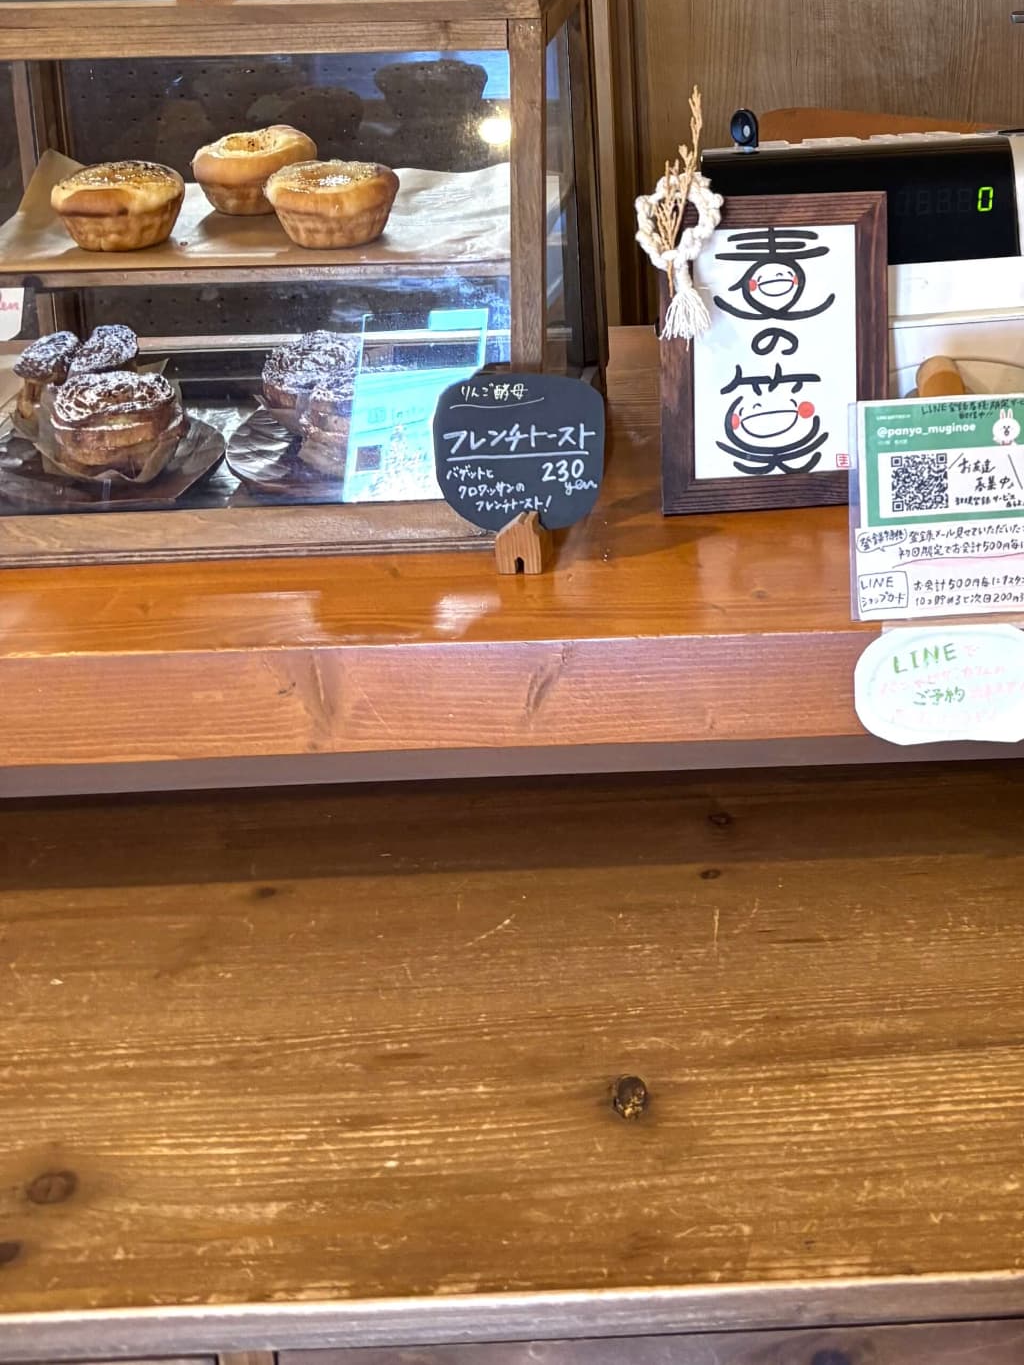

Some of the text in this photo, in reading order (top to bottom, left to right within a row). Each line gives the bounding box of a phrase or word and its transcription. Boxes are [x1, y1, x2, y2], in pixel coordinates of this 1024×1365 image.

[977, 186, 994, 213] 0
[461, 382, 529, 401] りんご酵母
[443, 423, 596, 454] フレンチトースト
[877, 422, 977, 438] @panya_muginoe
[541, 459, 585, 483] 230
[458, 481, 526, 499] クロワッサンの
[565, 479, 598, 496] yen
[475, 495, 552, 514] フレンチトースト!
[860, 576, 894, 590] LINE
